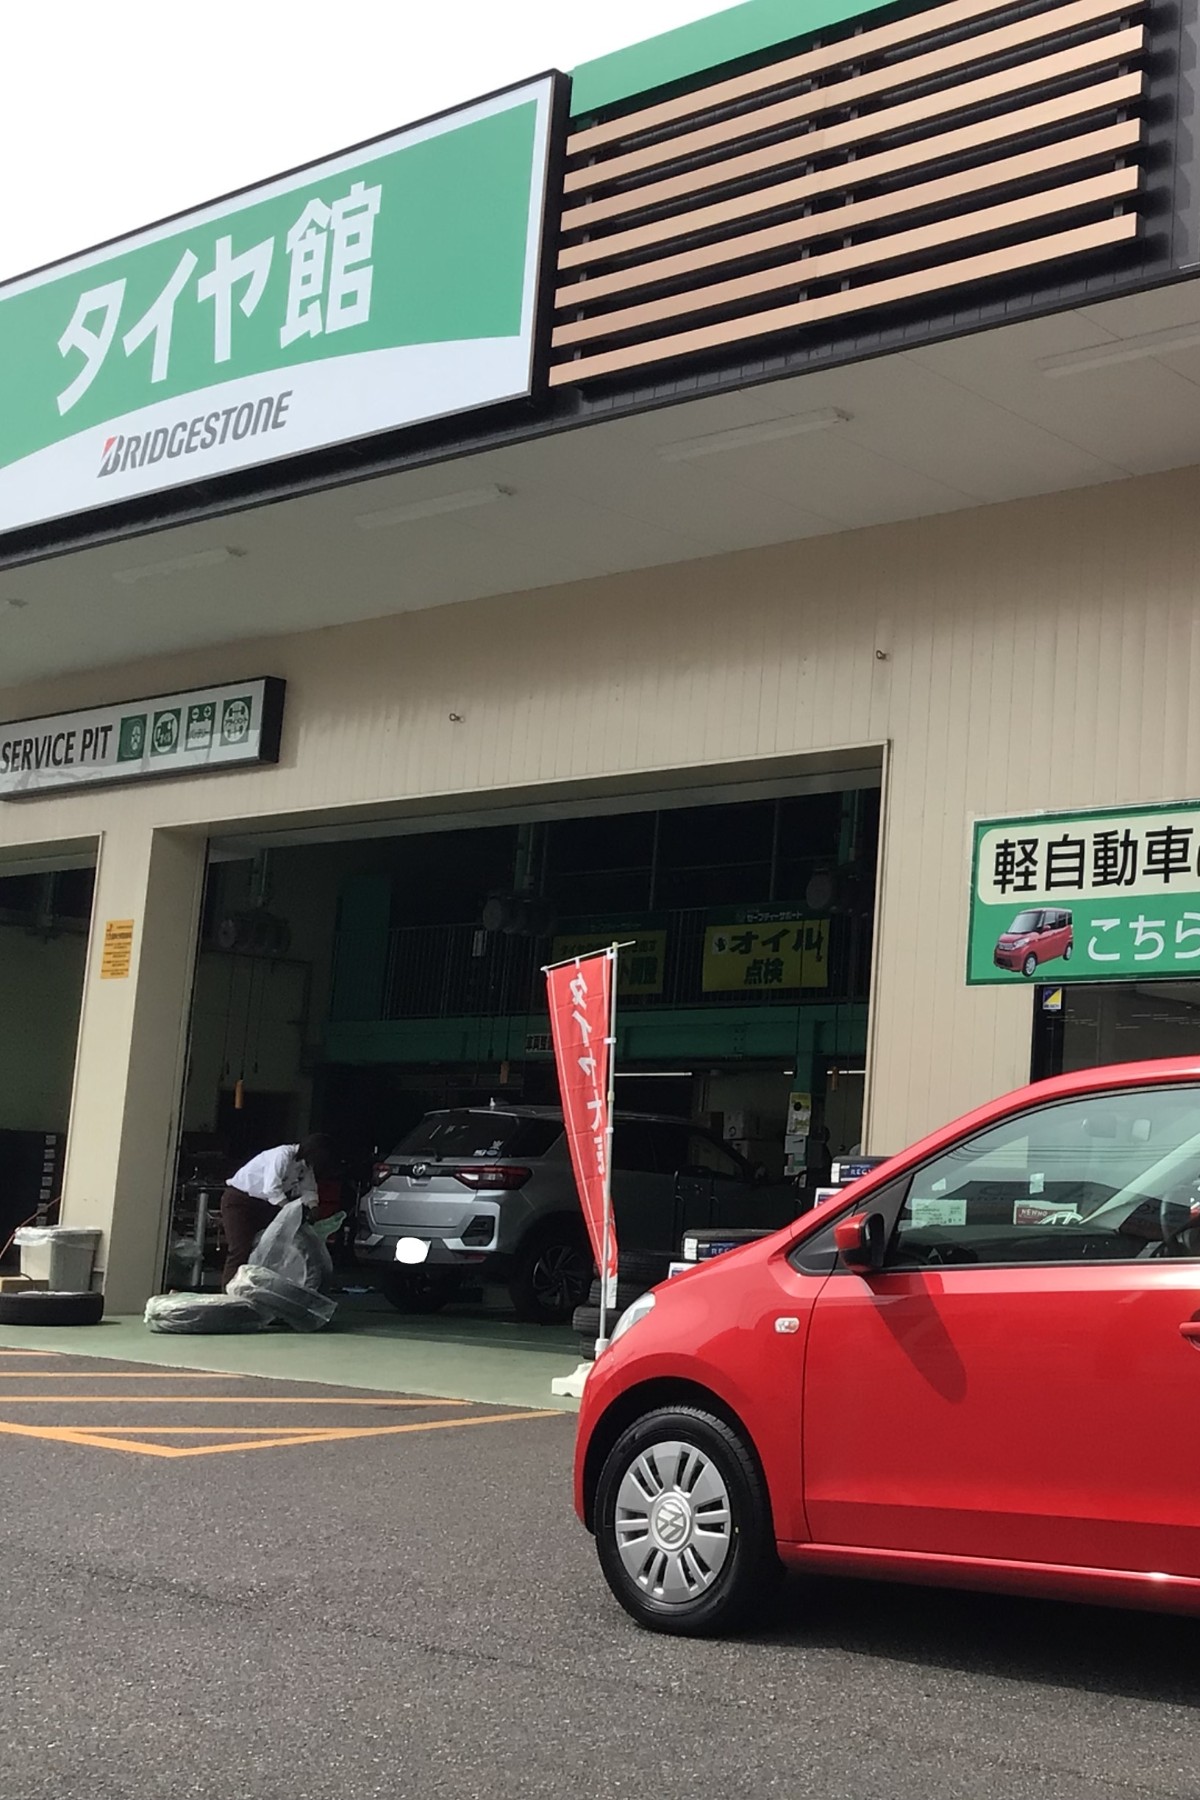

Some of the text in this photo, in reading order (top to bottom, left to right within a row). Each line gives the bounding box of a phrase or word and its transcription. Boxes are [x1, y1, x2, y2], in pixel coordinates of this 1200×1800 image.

[57, 180, 382, 416] タイヤ館
[97, 390, 294, 478] BRIDGESTONE
[0, 725, 113, 774] SERVICE PIT
[730, 927, 820, 954] オイル
[744, 957, 784, 985] 点検
